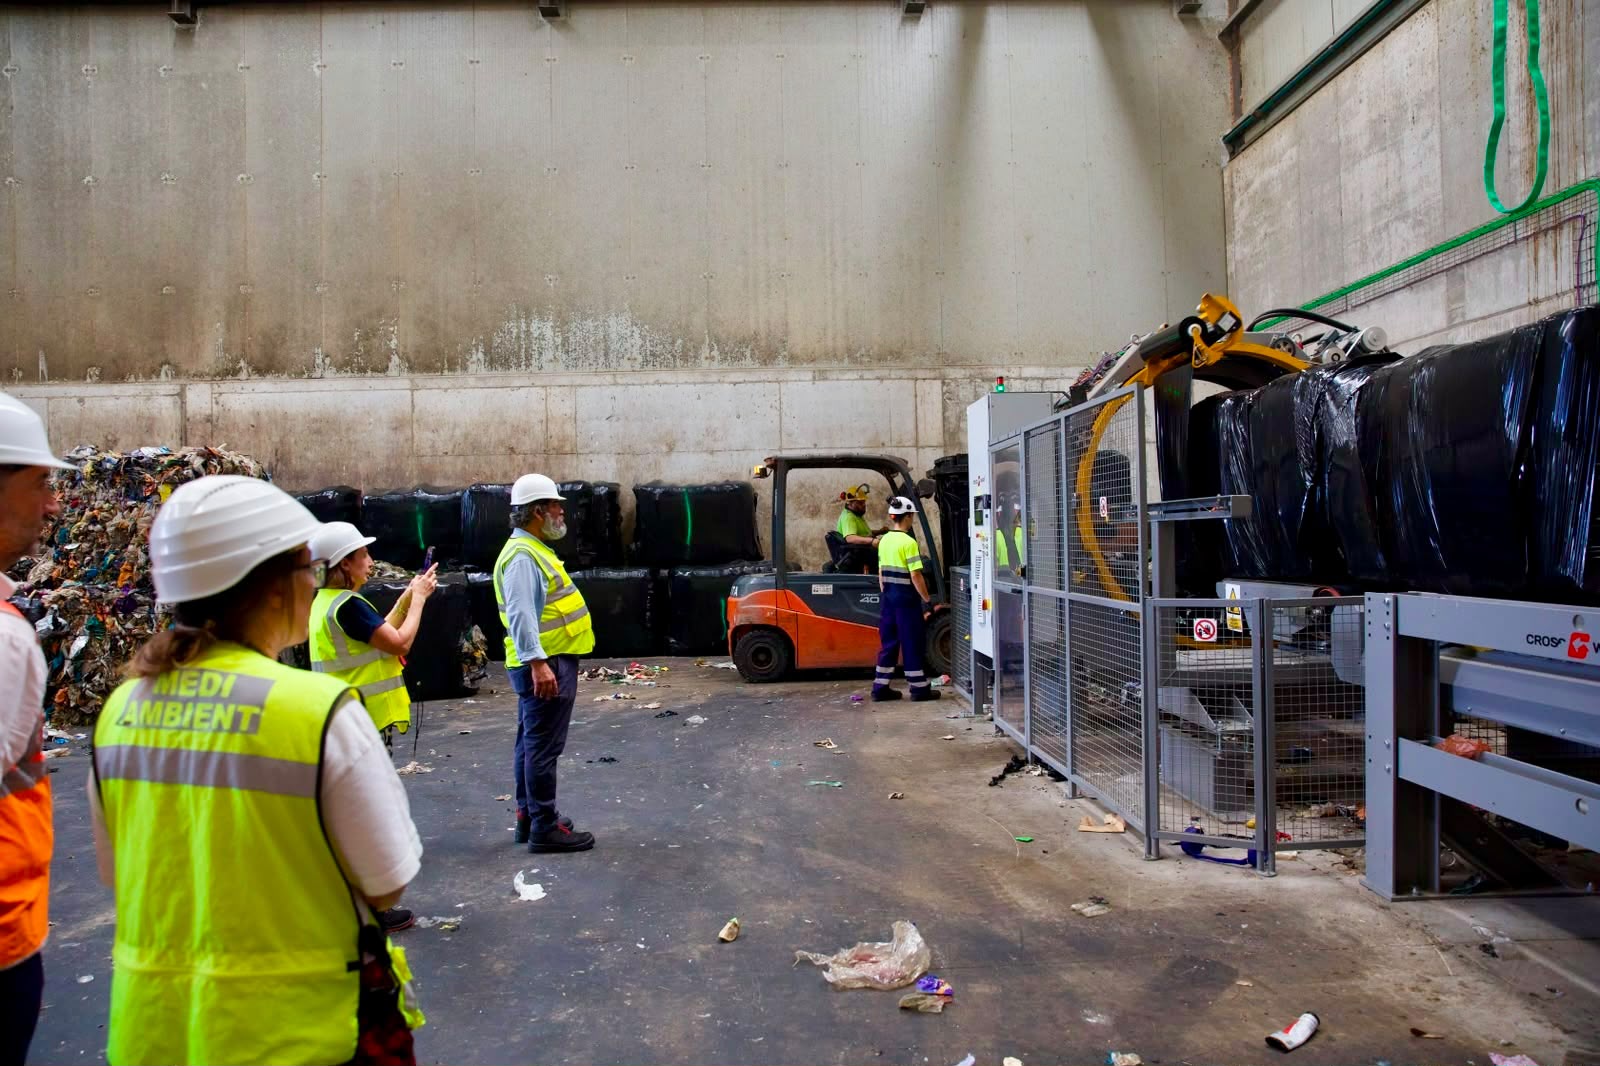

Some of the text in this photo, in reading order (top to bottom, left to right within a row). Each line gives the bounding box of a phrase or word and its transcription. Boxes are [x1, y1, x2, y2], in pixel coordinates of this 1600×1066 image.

[859, 596, 880, 604] 40
[153, 670, 238, 697] MEDI
[120, 700, 261, 731] AMBIENT
